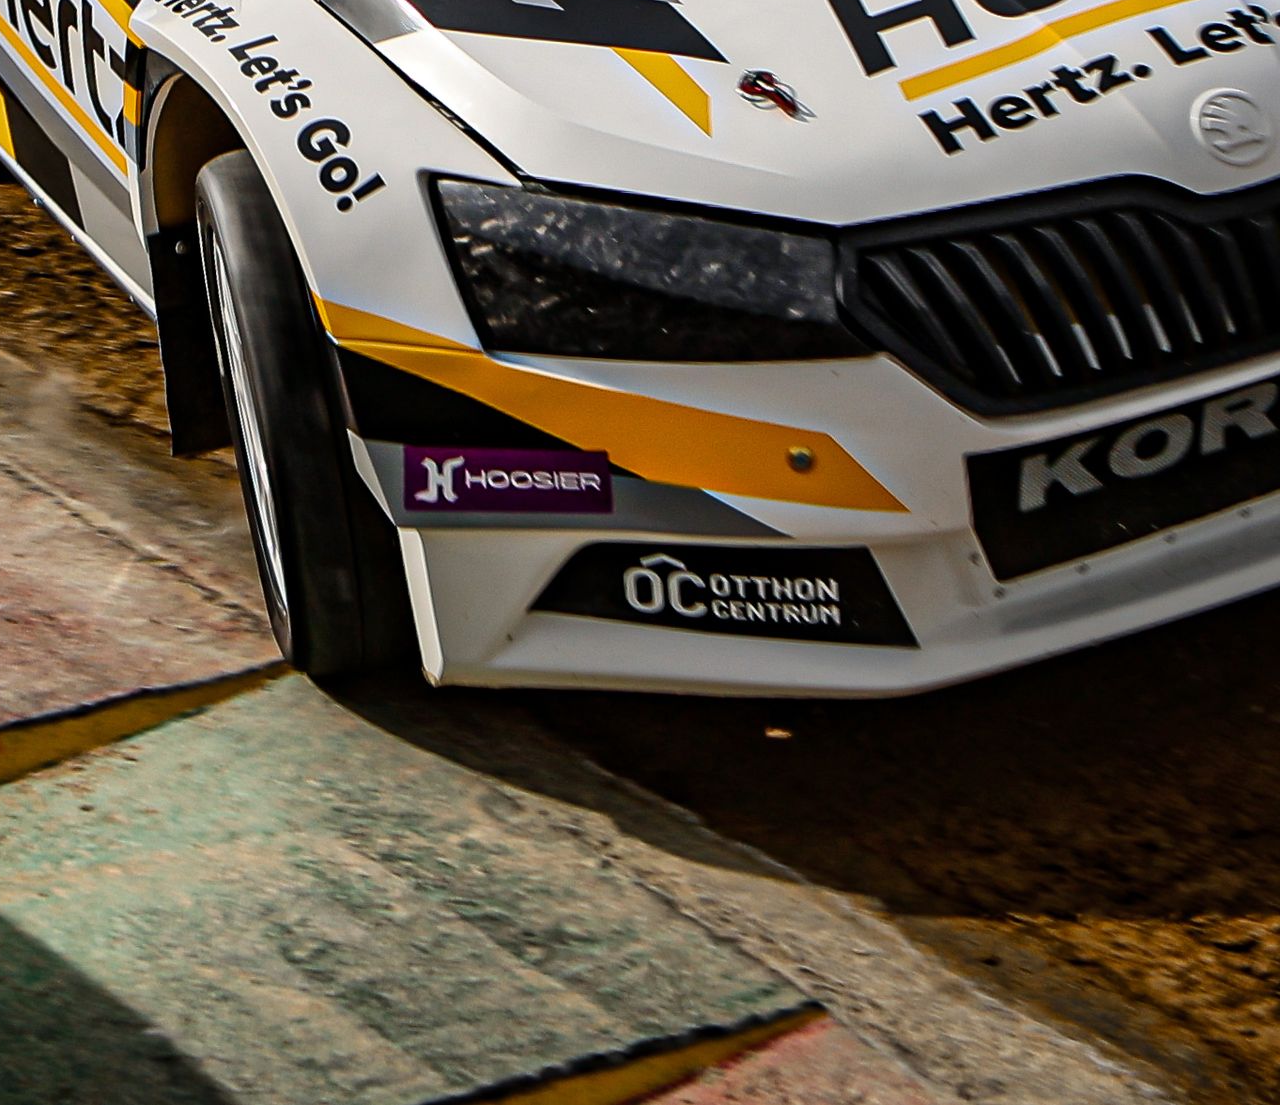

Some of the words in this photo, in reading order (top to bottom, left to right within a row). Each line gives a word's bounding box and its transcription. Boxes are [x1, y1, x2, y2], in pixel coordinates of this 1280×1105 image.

[918, 53, 1153, 156] Hertz.
[227, 34, 316, 120] Let's
[296, 117, 387, 213] Go!
[464, 468, 602, 493] HOOSIER
[709, 572, 841, 603] OTTHON
[711, 598, 843, 627] CENTRUM
